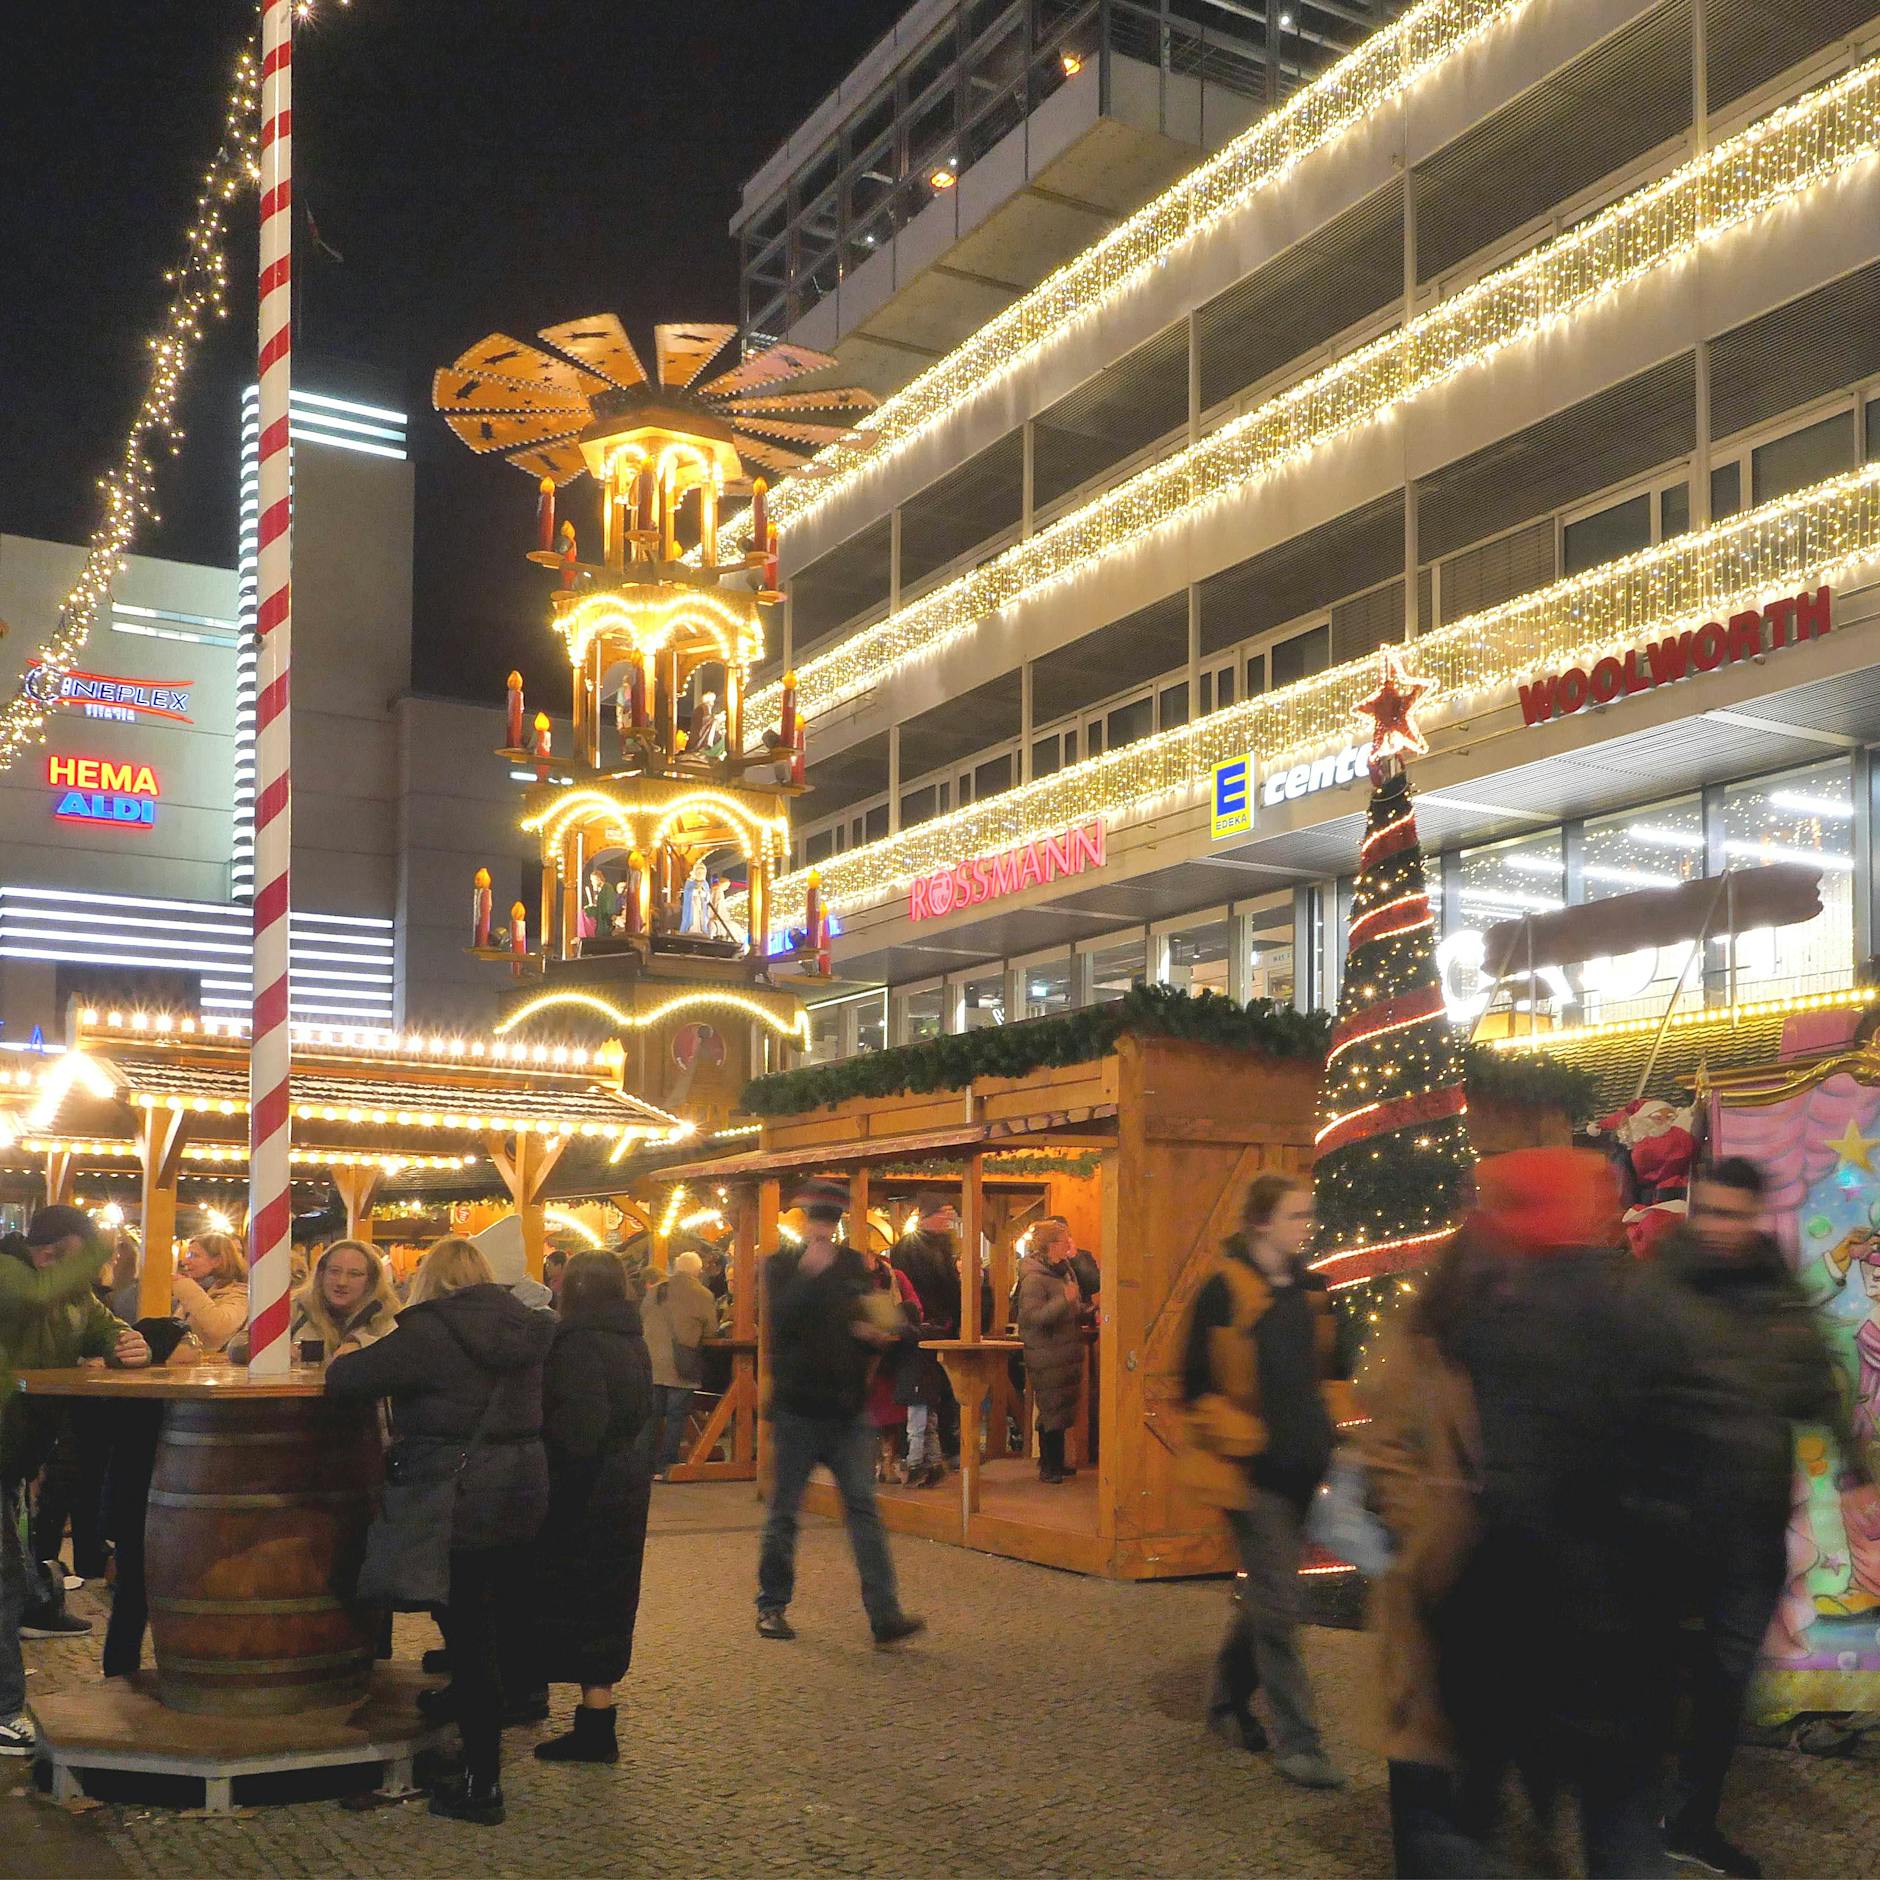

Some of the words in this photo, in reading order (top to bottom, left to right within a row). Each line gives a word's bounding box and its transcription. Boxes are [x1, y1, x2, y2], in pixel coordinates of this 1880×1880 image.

[1519, 585, 1832, 726] WOOLWORTH
[25, 665, 189, 711] CINEPLEX
[49, 755, 159, 795] HEMA
[57, 792, 155, 823] ALDI
[1215, 813, 1248, 831] EDEKA
[908, 817, 1107, 922] ROSSMANN
